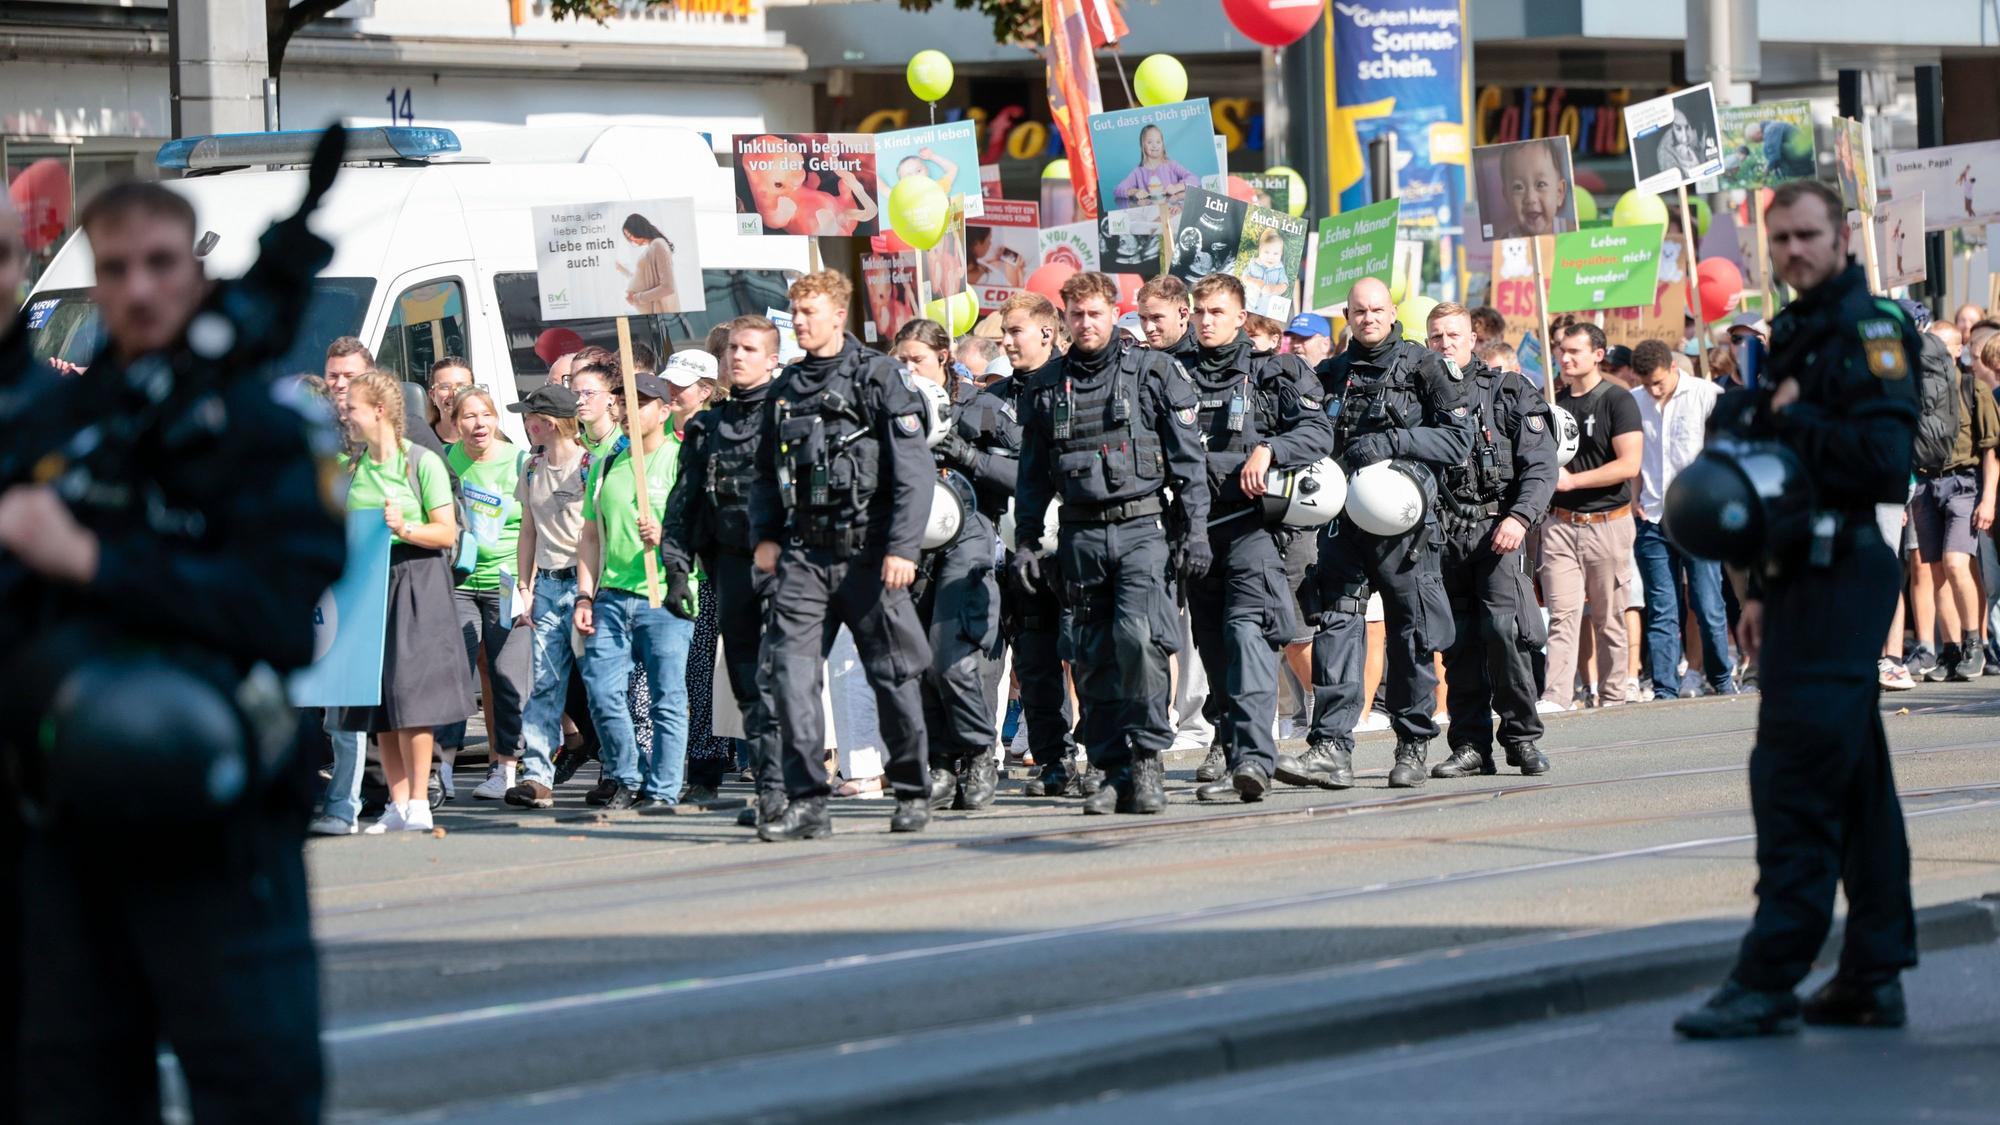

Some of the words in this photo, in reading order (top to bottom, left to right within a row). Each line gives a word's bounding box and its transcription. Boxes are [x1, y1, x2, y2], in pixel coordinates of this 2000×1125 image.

[1358, 52, 1437, 80] schein.
[386, 87, 414, 127] 14
[1093, 119, 1115, 131] Gut,
[1117, 116, 1139, 128] dass
[1141, 114, 1153, 123] es
[1155, 109, 1178, 121] Dich
[1180, 103, 1206, 117] gibt!
[884, 135, 911, 149] Kind
[914, 130, 935, 145] will
[938, 127, 970, 140] leben
[738, 138, 807, 154] Inklusion
[749, 159, 775, 171] vor
[779, 157, 804, 171] der
[809, 157, 862, 171] Geburt
[1265, 177, 1287, 189] ich!
[551, 213, 585, 223] Mama,
[587, 212, 603, 221] ich
[1205, 196, 1229, 214] Ich!
[1251, 210, 1279, 229] Auch
[1281, 219, 1303, 236] ich!
[553, 226, 577, 236] liebe
[580, 224, 606, 235] Dich!
[548, 240, 582, 253] Liebe
[586, 238, 615, 250] mich
[1590, 235, 1628, 249] Leben
[1341, 242, 1372, 260] stehen
[1622, 250, 1652, 264] nicht
[567, 255, 600, 269] auch!
[1320, 275, 1333, 287] zu
[1335, 266, 1363, 283] ihrem
[1365, 252, 1389, 274] Kind
[1575, 270, 1629, 286] beenden!
[30, 298, 61, 311] NRW
